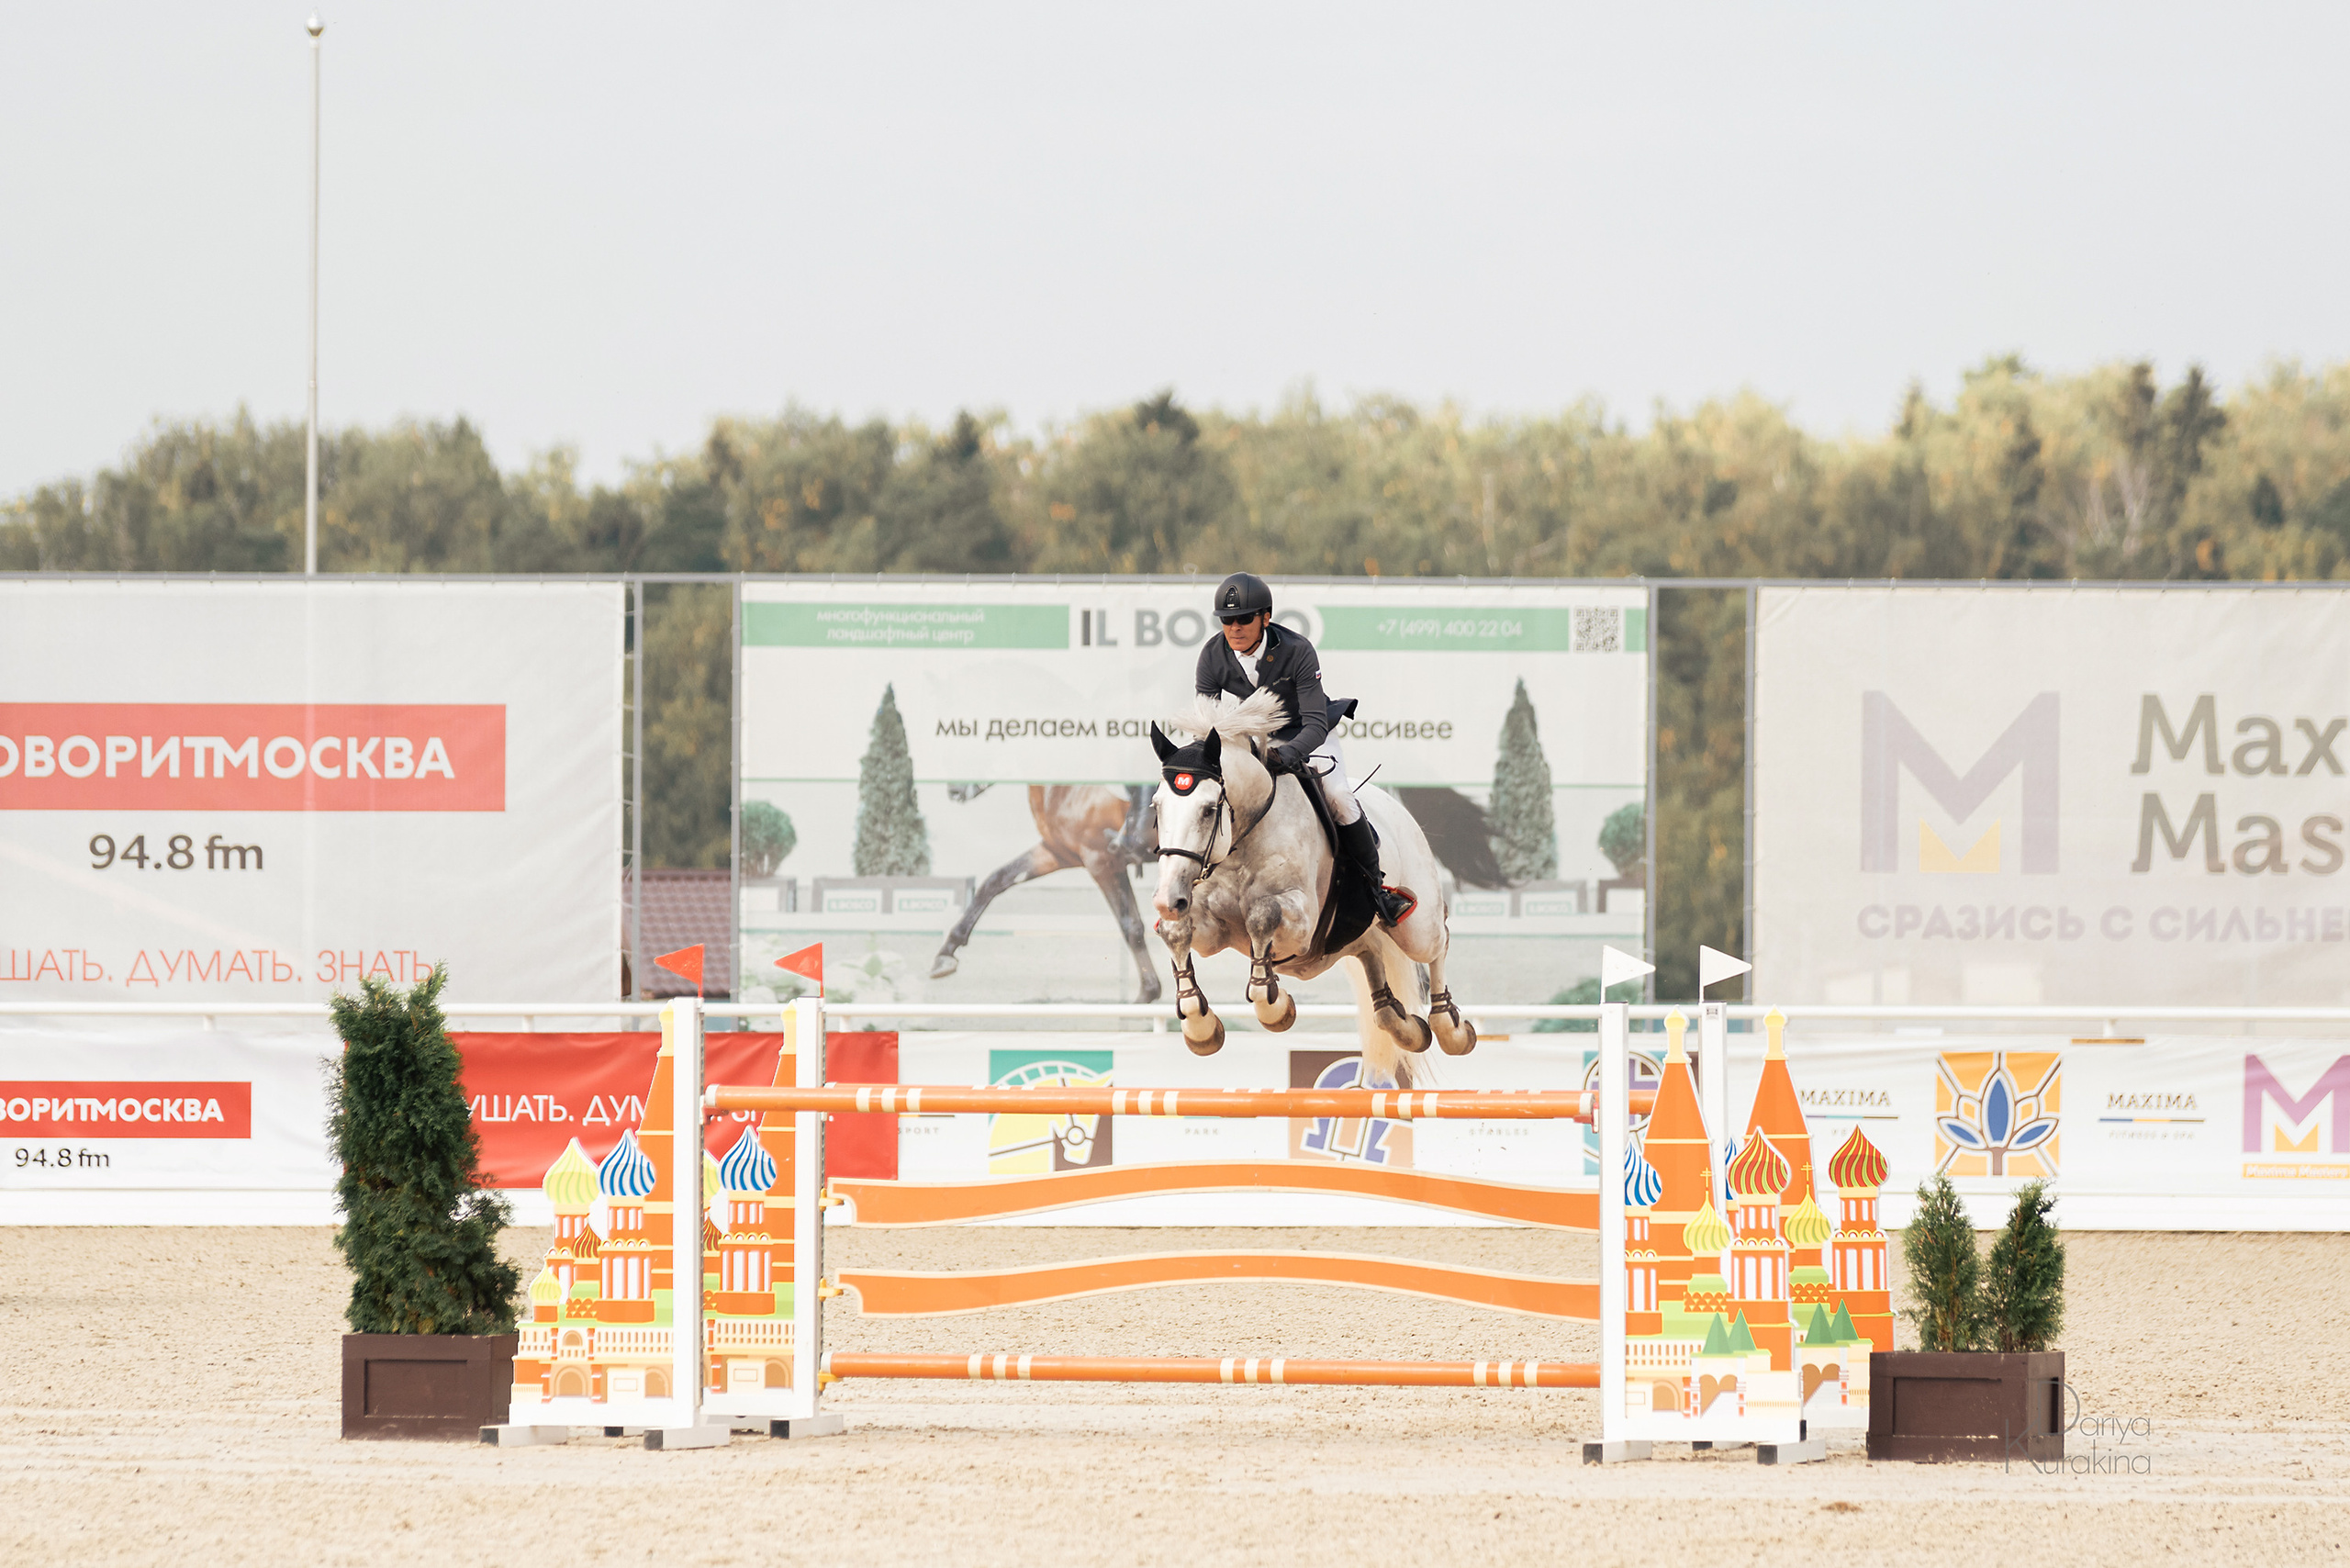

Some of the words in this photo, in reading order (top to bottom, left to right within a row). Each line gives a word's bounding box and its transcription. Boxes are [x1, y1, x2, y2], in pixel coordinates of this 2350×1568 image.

[817, 607, 985, 626] многофункциональный
[1081, 610, 1117, 645] IL
[1135, 610, 1310, 645] BOO
[827, 625, 929, 644] ландшафтный
[932, 628, 975, 645] центр
[1377, 619, 1397, 635] +7
[1400, 618, 1440, 639] (499)
[1443, 619, 1474, 637] 400
[1478, 619, 1498, 637] 22
[1501, 620, 1523, 637] 04
[935, 719, 978, 737] мы
[986, 719, 1098, 741] делаем
[1337, 721, 1453, 739] расивее
[2132, 694, 2348, 774] Max
[2132, 792, 2344, 873] Mas
[89, 834, 195, 870] 94.8
[205, 834, 263, 870] fm
[1856, 904, 2086, 942] СРАЗИСЬ
[2099, 905, 2134, 942] С
[2148, 905, 2350, 944] СИЛЬНЕ
[126, 949, 302, 987] ДУМАТЬ.
[1799, 1090, 1892, 1107] MAXIMA
[2107, 1093, 2198, 1110] MAXIMA
[15, 1148, 73, 1168] 94.8
[78, 1148, 109, 1168] fm
